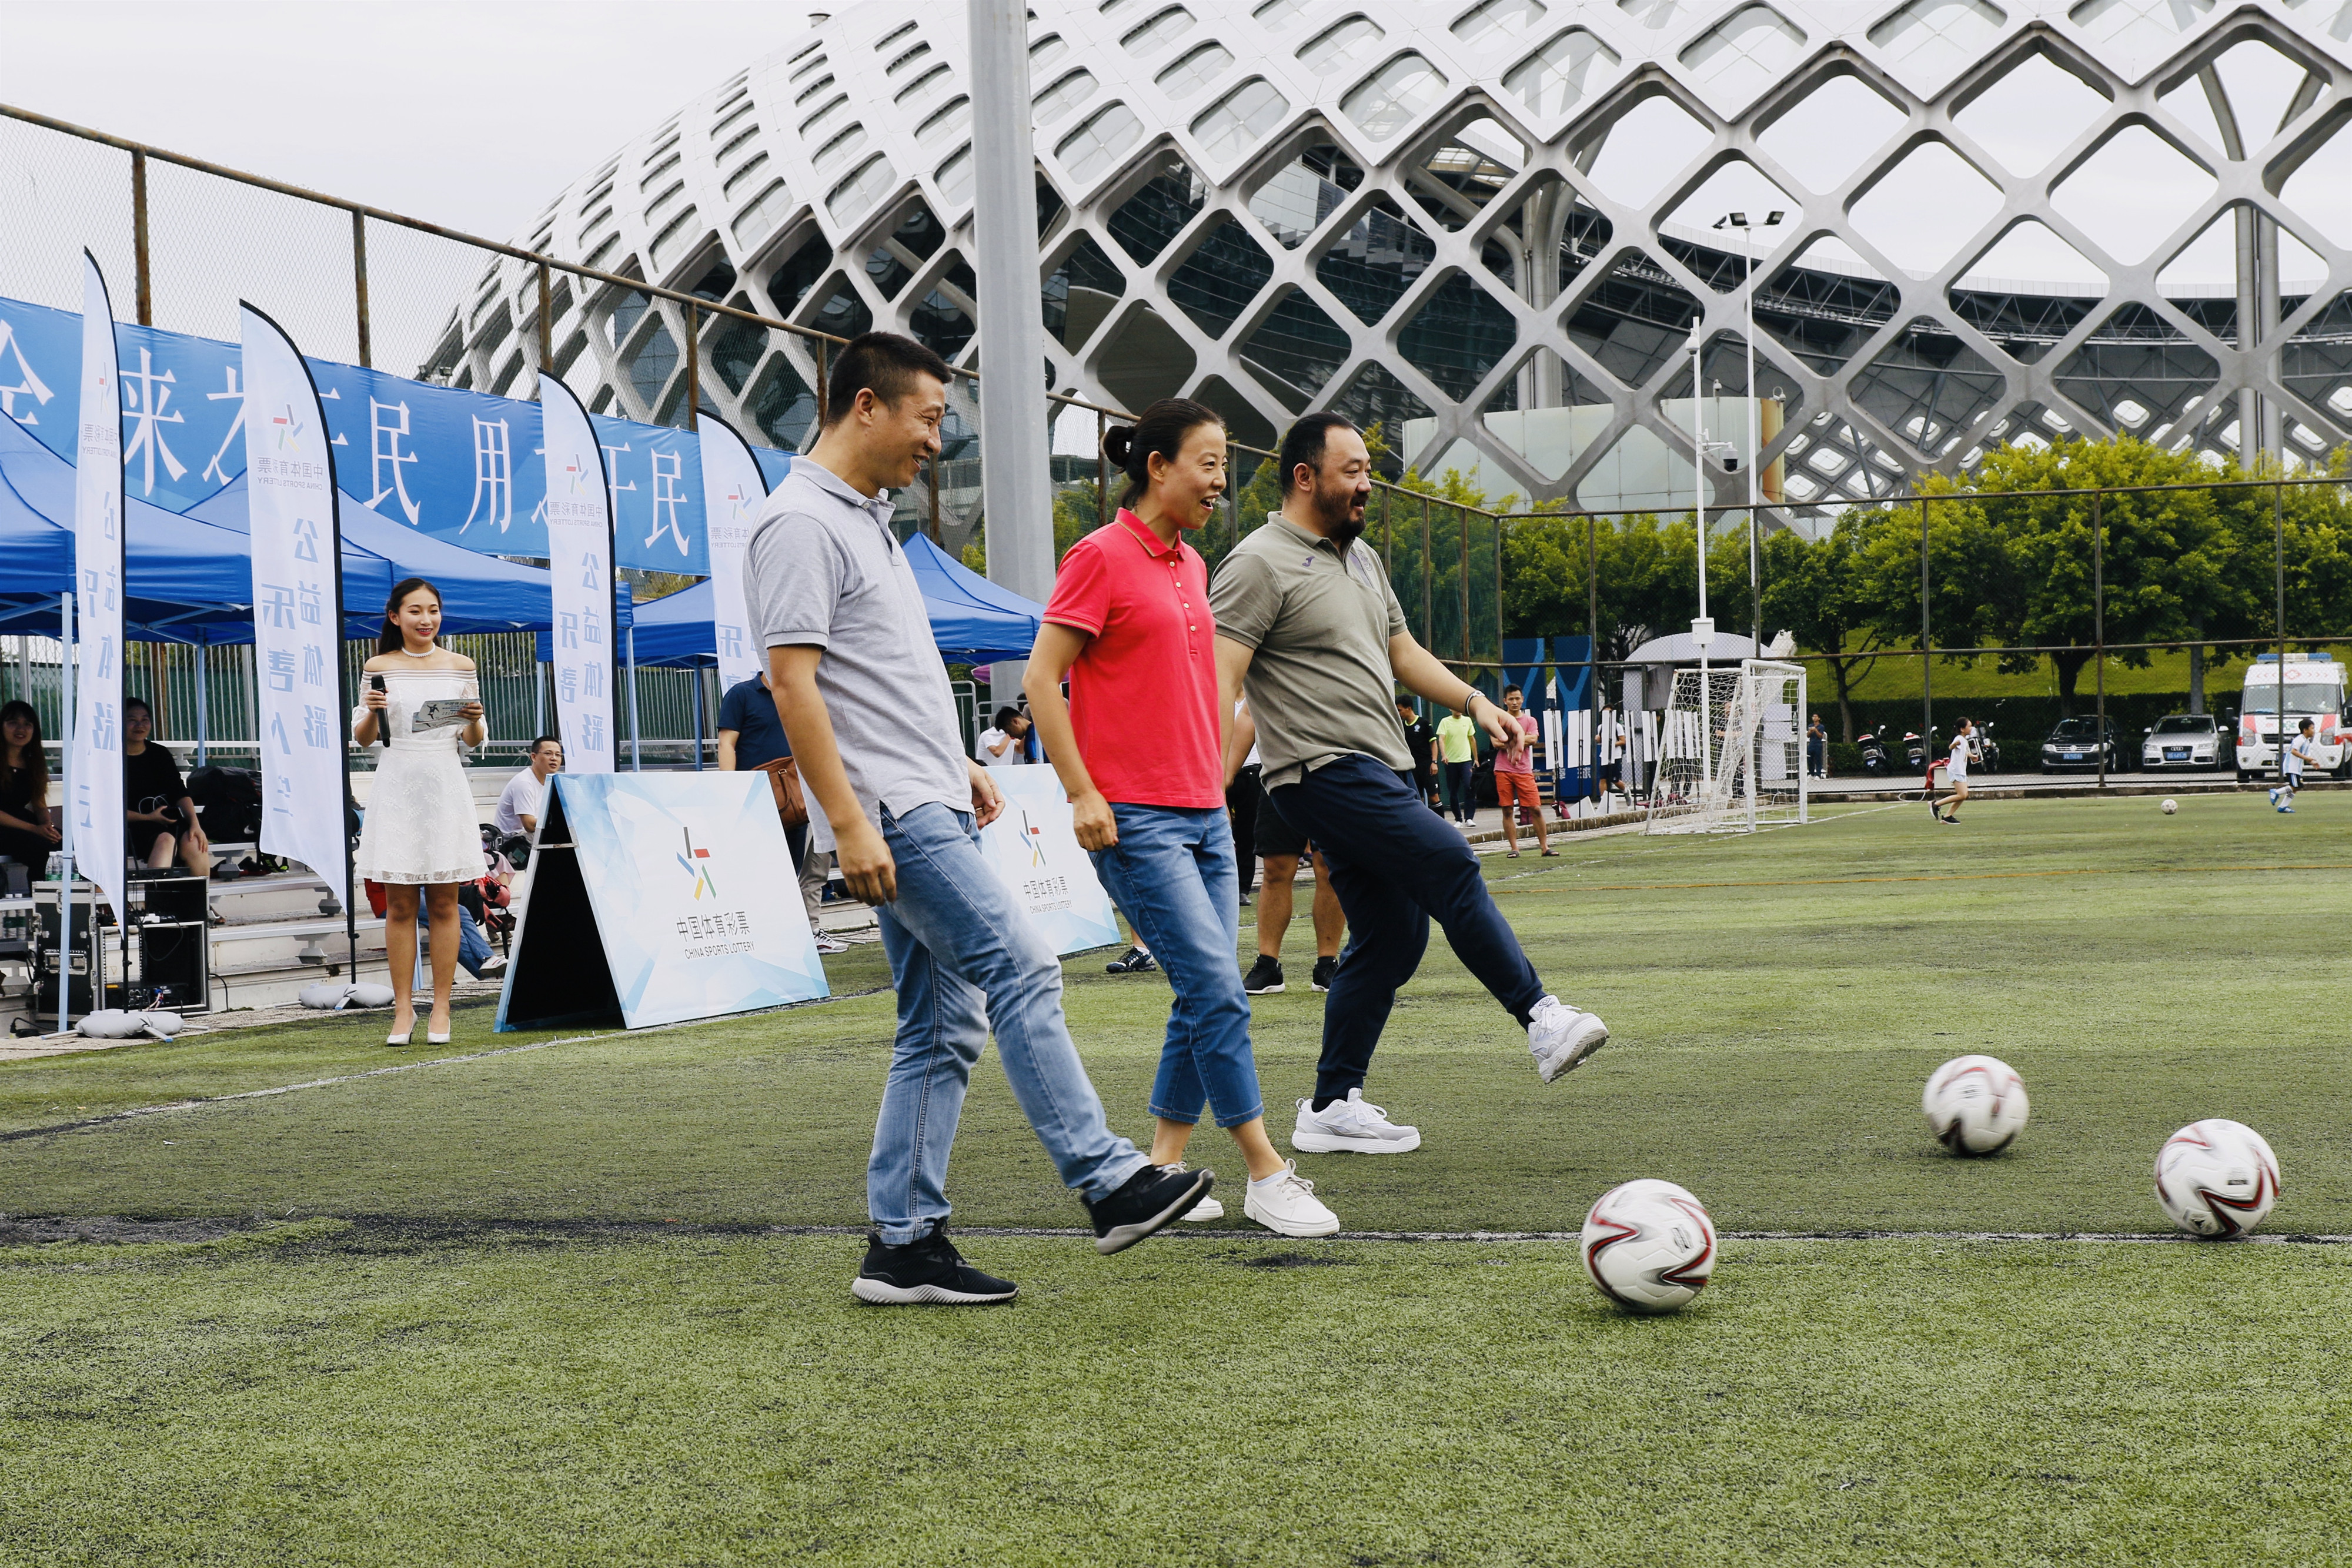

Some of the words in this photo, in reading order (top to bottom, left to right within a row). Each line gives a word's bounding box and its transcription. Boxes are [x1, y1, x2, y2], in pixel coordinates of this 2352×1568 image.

[1023, 876, 1069, 901] 中国体育彩票
[1030, 904, 1042, 914] CHINA
[1041, 902, 1057, 912] SPORTS
[1056, 900, 1073, 910] LOTTERY
[676, 911, 751, 942] 中国体育彩票
[684, 948, 705, 959] CHINA
[705, 944, 729, 957] SPORTS
[730, 941, 756, 952] LOTTERY
